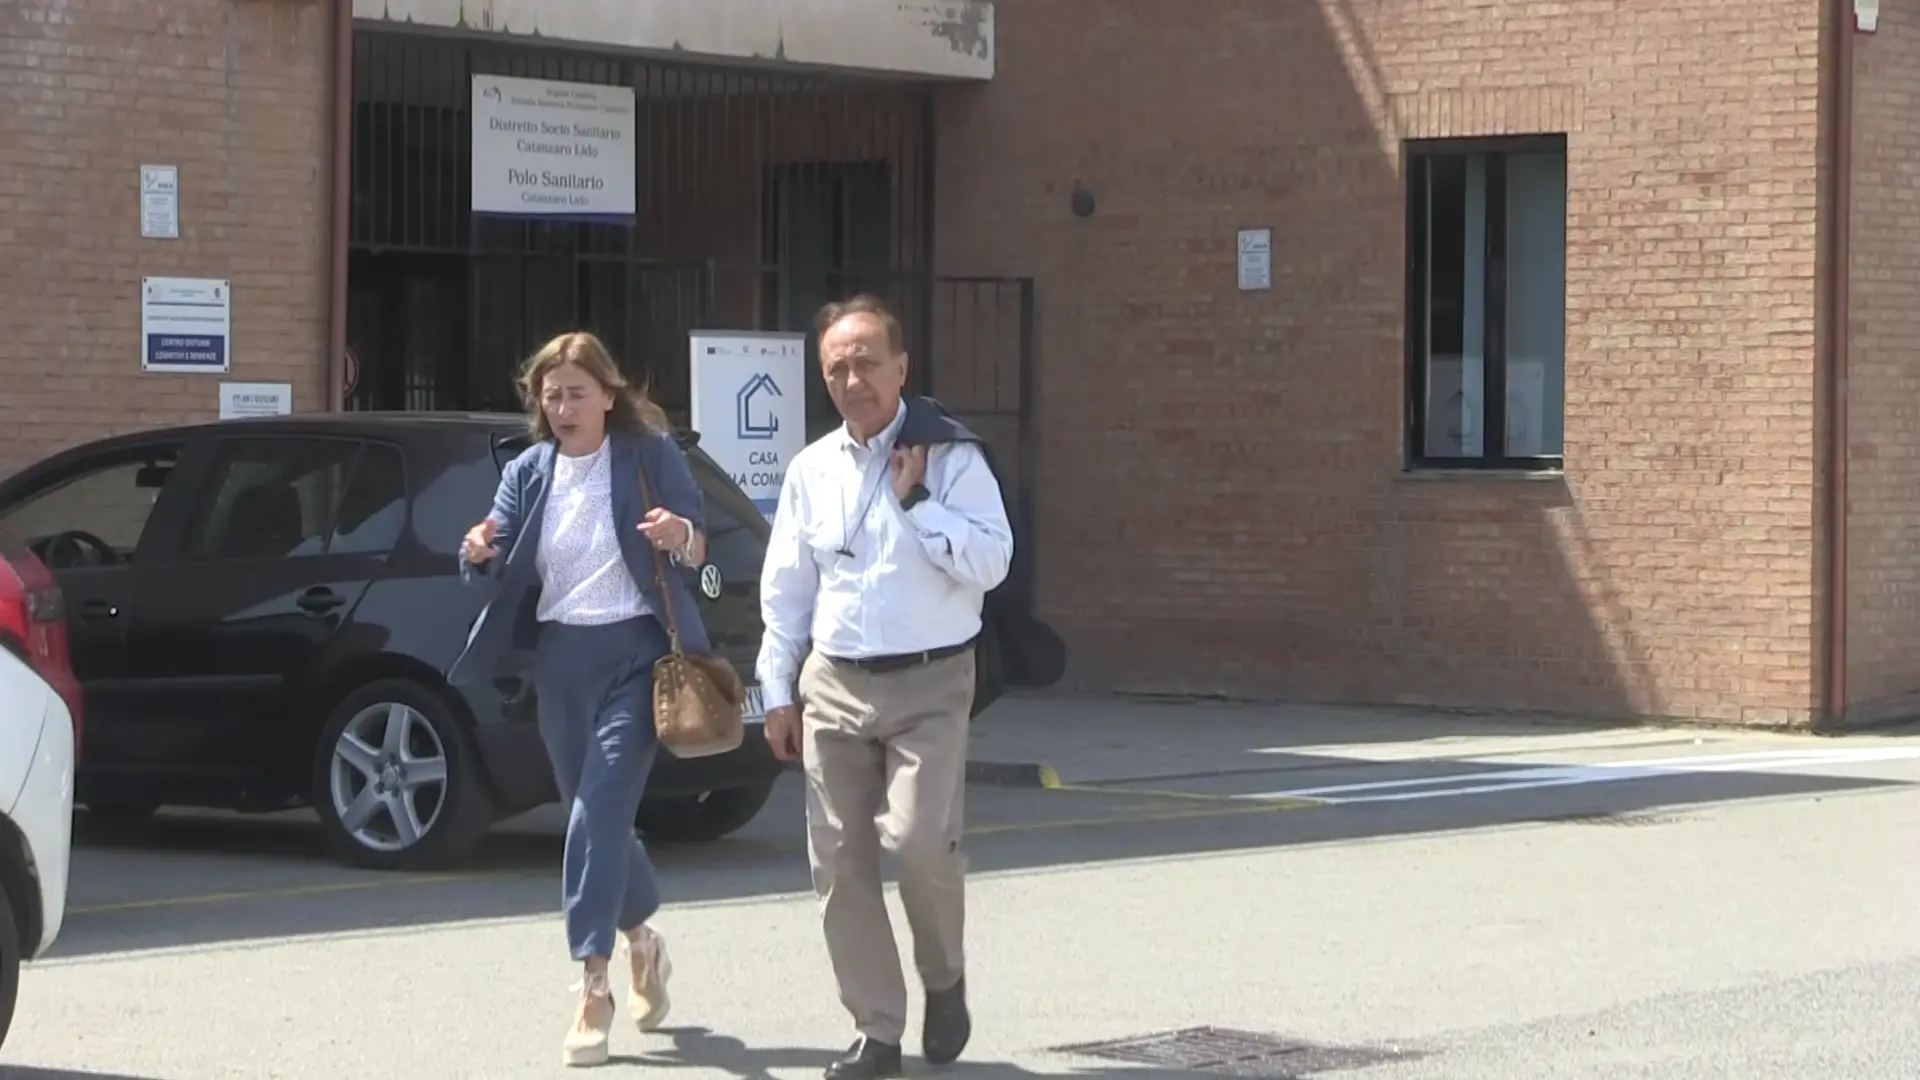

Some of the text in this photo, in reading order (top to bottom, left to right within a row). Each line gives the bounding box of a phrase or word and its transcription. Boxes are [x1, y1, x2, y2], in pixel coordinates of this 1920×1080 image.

[490, 117, 538, 133] Distretto
[573, 124, 620, 140] Sanitario
[517, 139, 598, 157] Catanzaro Lido
[508, 168, 604, 190] Polo Sanitario
[521, 192, 567, 205] Catanzaro
[749, 451, 779, 466] CASA
